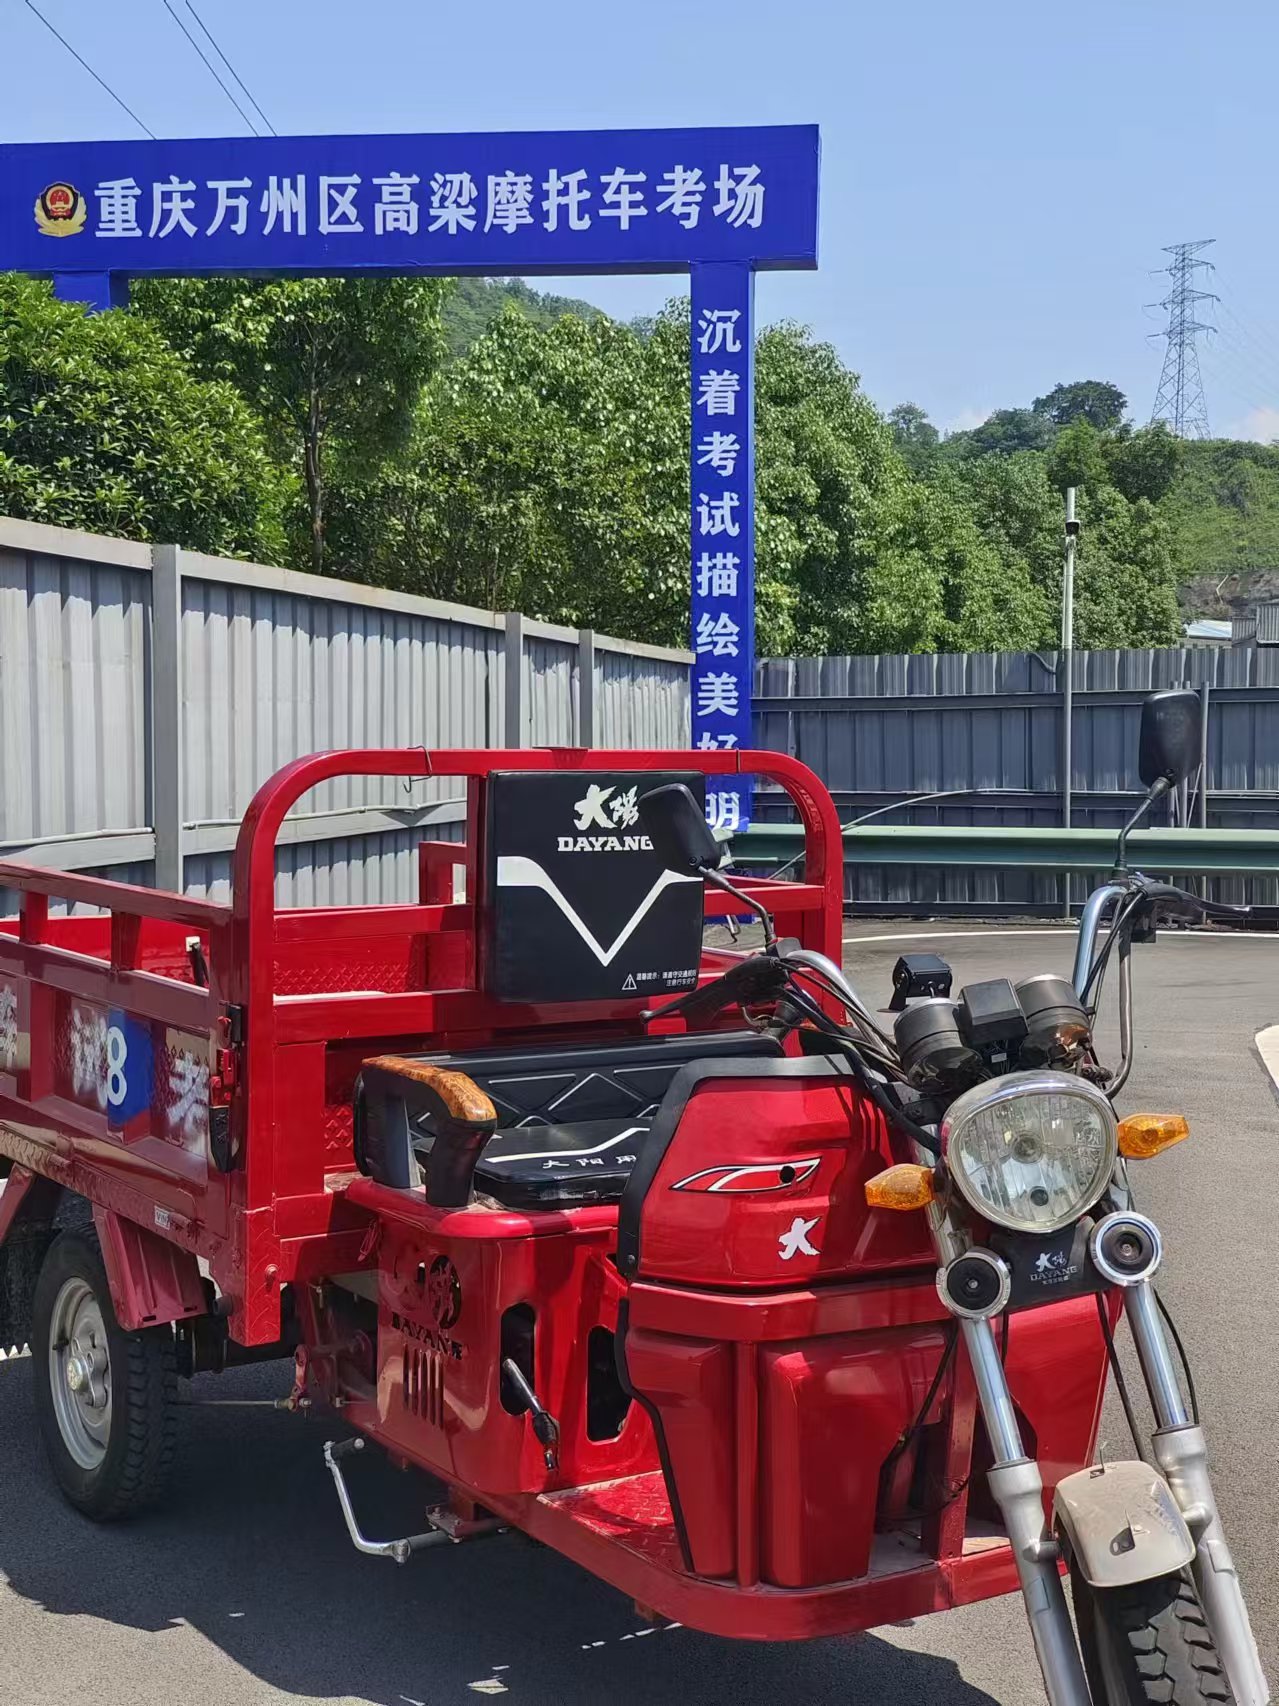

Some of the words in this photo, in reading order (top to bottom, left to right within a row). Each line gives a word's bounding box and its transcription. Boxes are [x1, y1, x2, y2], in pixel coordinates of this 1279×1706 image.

[94, 163, 766, 240] 重庆万州区高梁摩托车考场
[557, 835, 654, 852] DAYANG
[107, 1026, 127, 1106] 8
[1030, 1265, 1078, 1281] DAYANG
